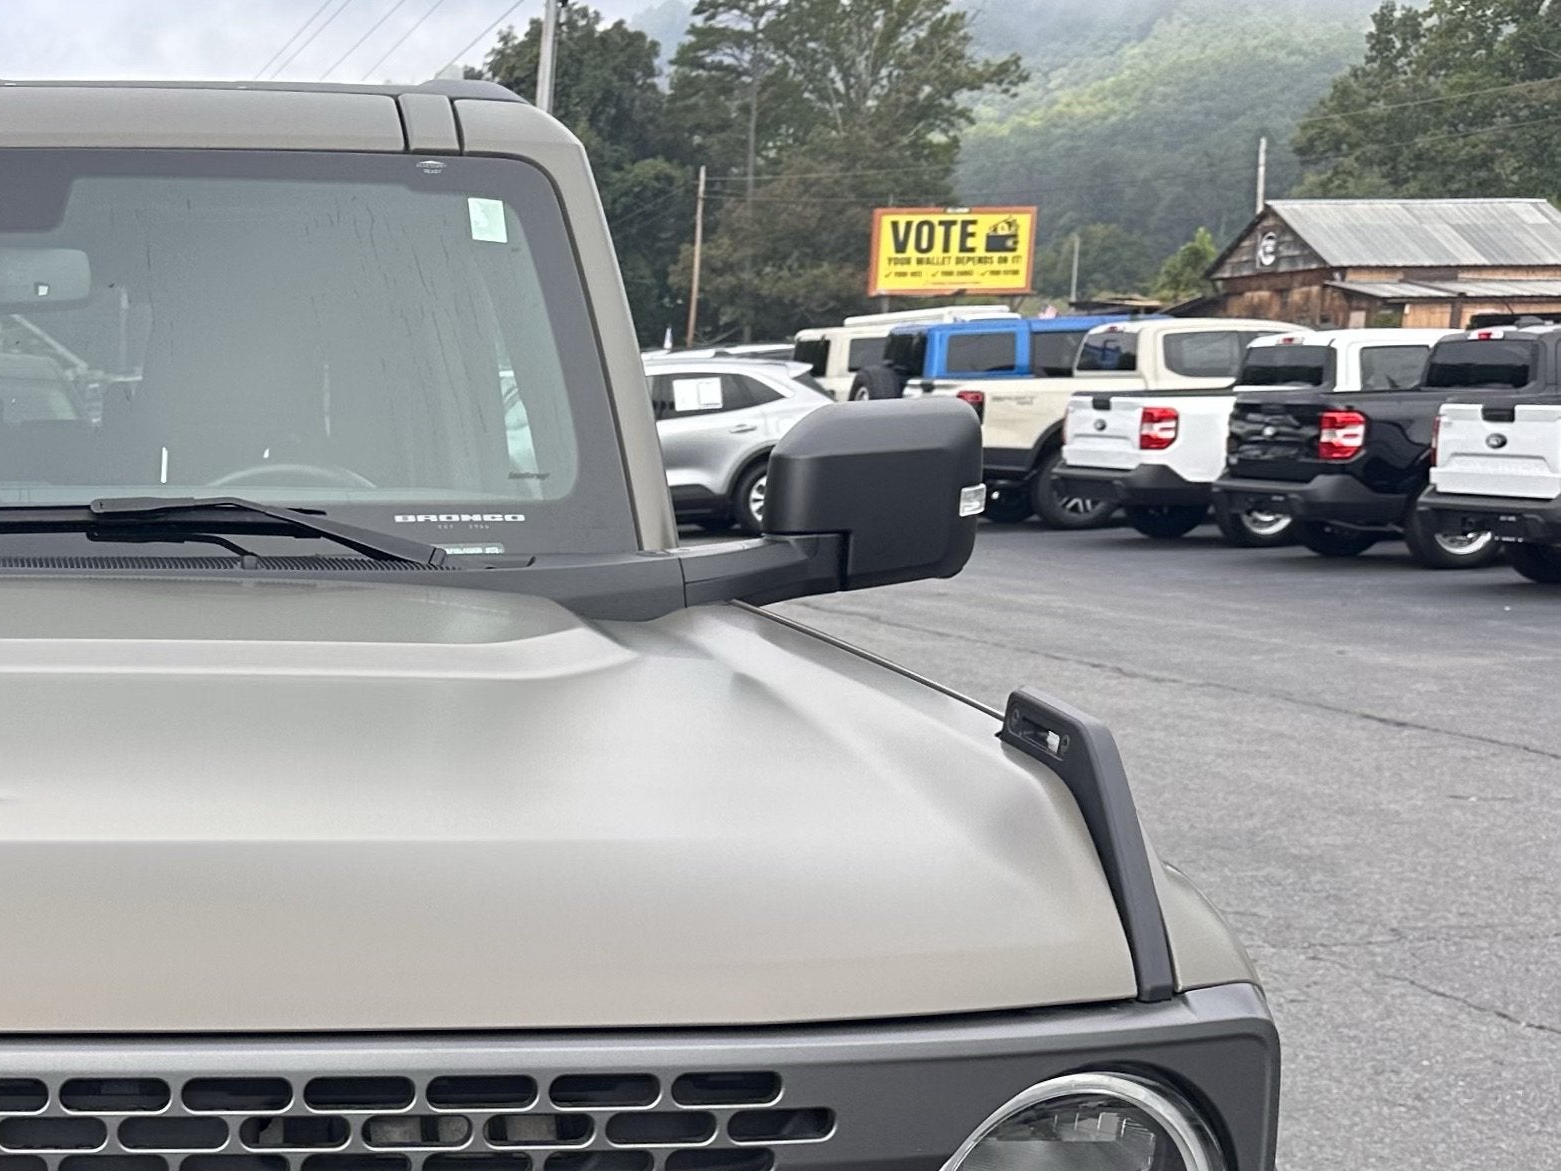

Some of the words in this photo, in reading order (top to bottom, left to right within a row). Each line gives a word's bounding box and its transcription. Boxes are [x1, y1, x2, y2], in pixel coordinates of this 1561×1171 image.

[891, 220, 978, 254] VOTE
[887, 256, 912, 266] YOUR
[916, 256, 952, 266] WALLET
[955, 255, 994, 266] DEPENDS
[997, 255, 1009, 265] ON
[394, 514, 525, 522] BRONCO
